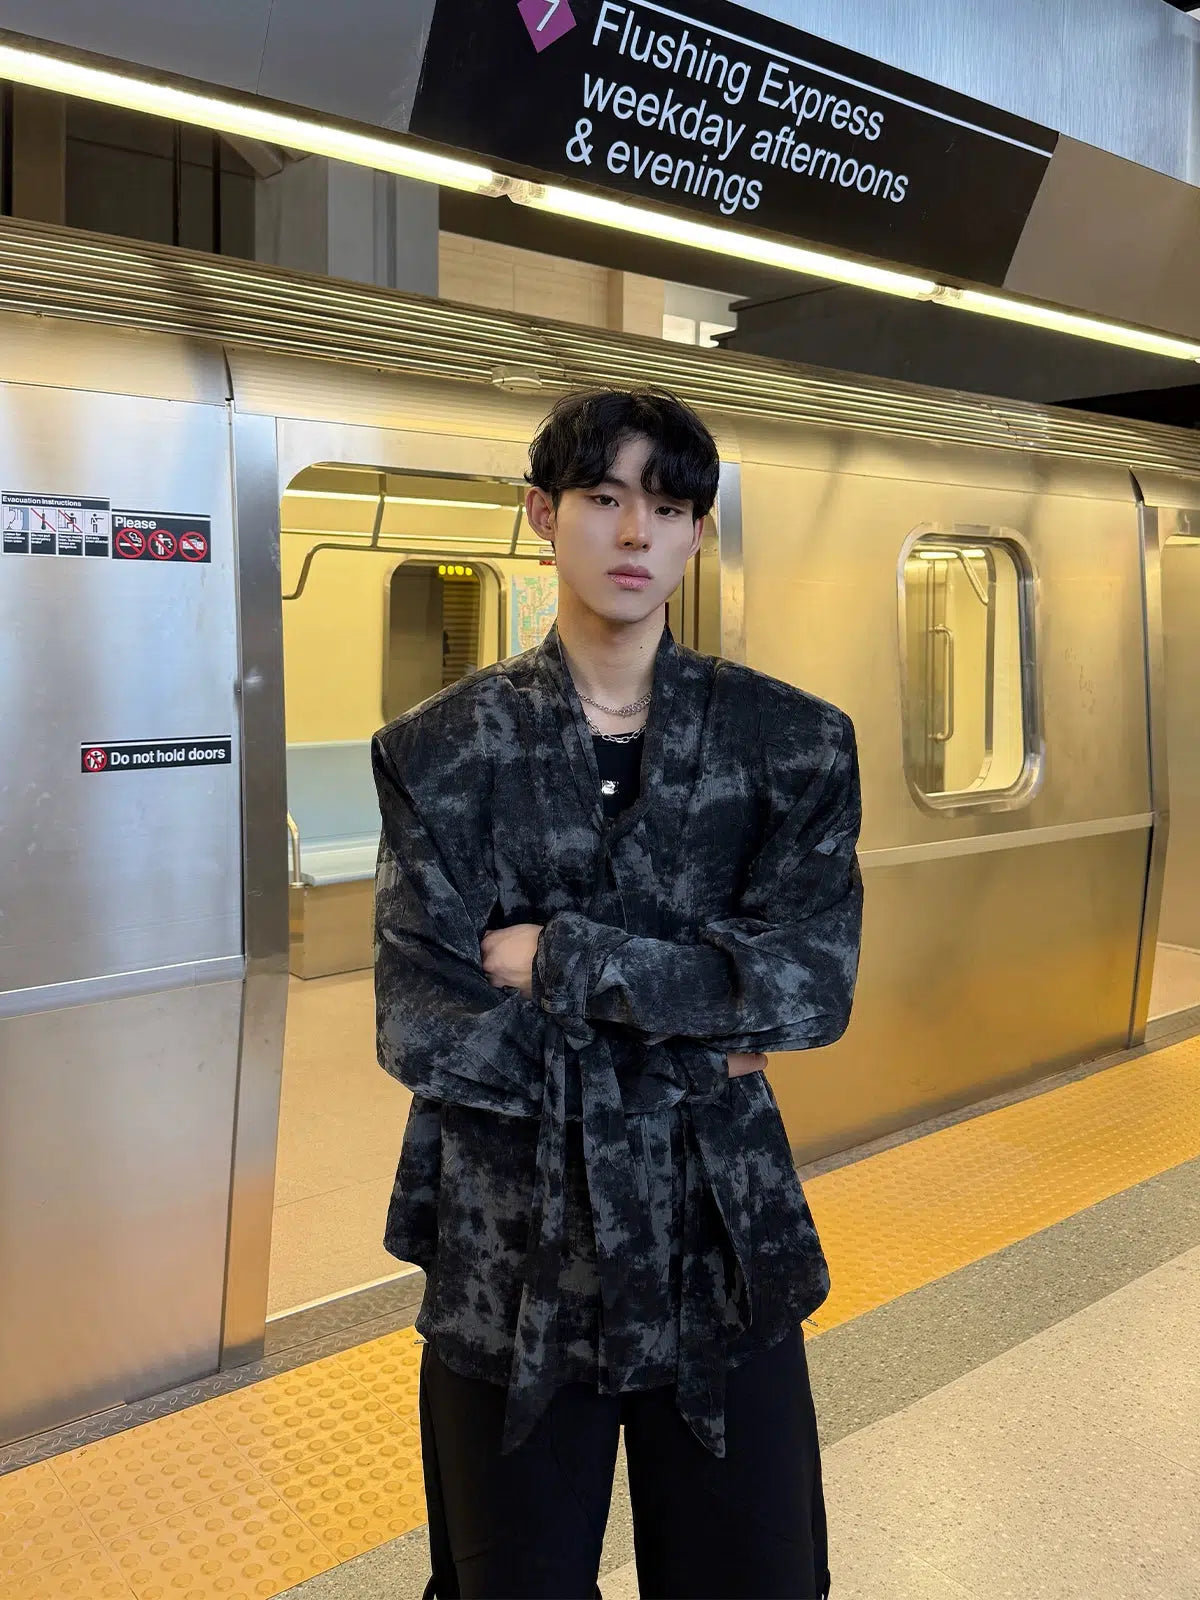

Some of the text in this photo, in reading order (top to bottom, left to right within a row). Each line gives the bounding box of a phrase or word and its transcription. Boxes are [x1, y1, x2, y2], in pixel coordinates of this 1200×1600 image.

[536, 0, 560, 31] 7
[592, 0, 884, 141] Flushing Express
[583, 73, 909, 203] weekday afternoons
[565, 118, 763, 215] & evenings
[2, 495, 82, 507] Evacuation Instructions
[114, 516, 157, 530] Please
[110, 747, 226, 766] Do not hold doors
